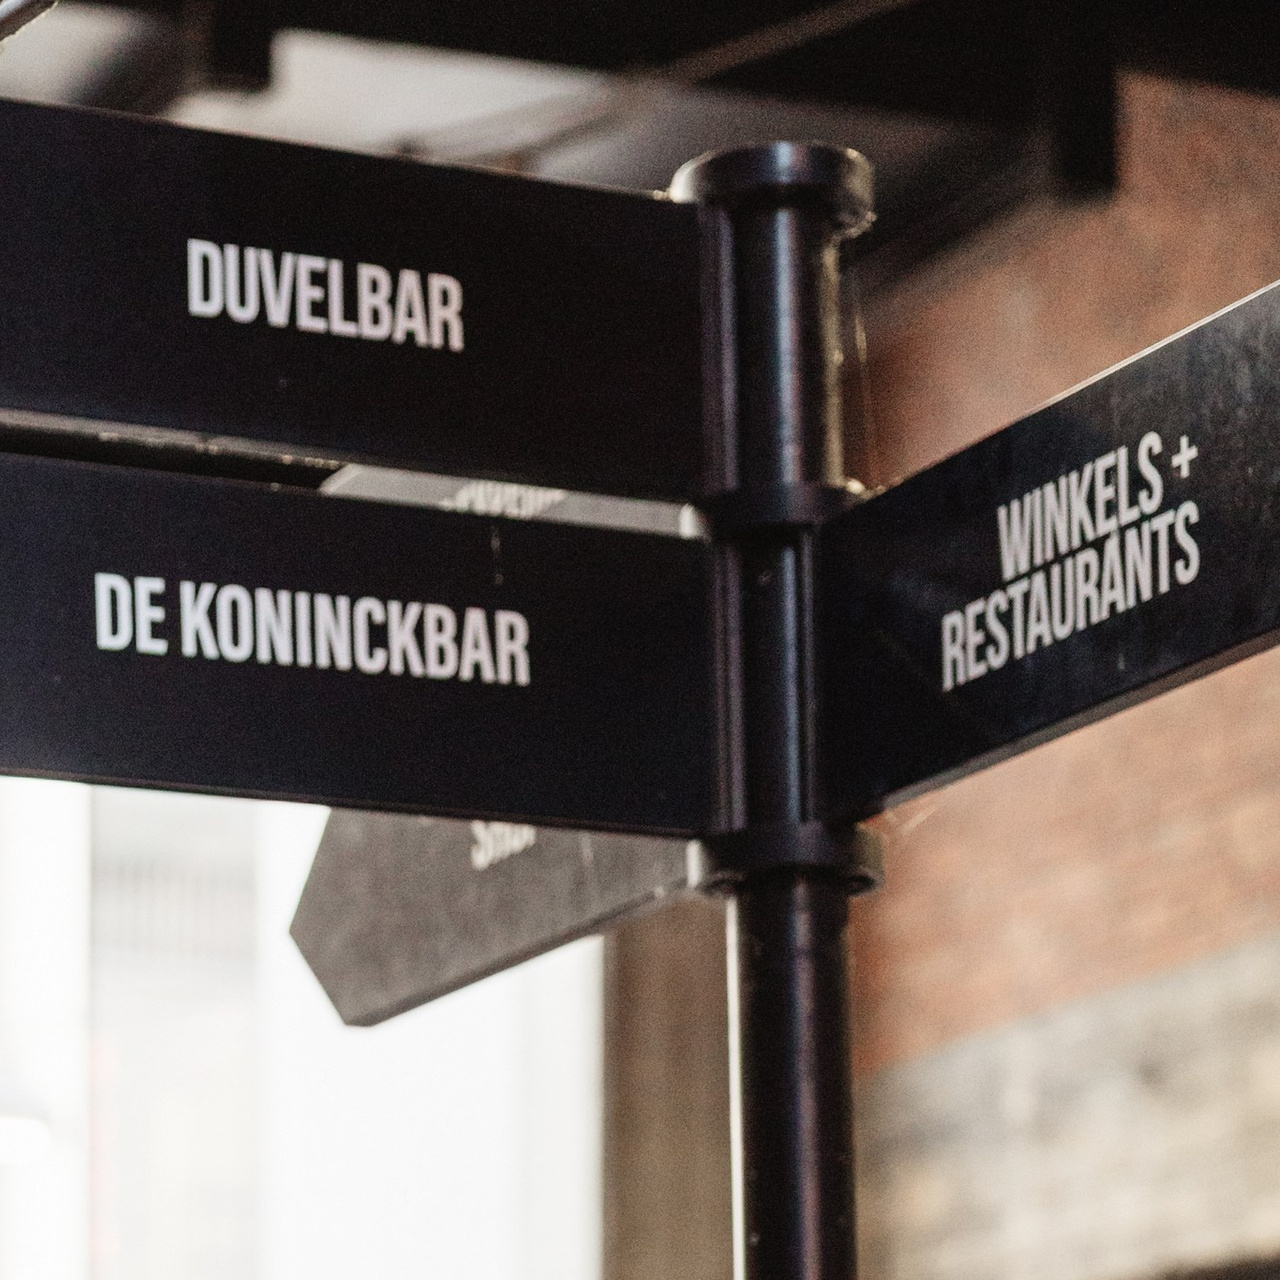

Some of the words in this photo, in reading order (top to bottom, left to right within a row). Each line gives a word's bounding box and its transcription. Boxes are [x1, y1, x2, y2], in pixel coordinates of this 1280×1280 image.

[187, 238, 464, 352] DUVELBAR
[997, 431, 1164, 582] WINKELS
[93, 572, 168, 655] DE
[180, 581, 531, 687] KONINCKBAR
[941, 501, 1200, 692] RESTAURANTS
